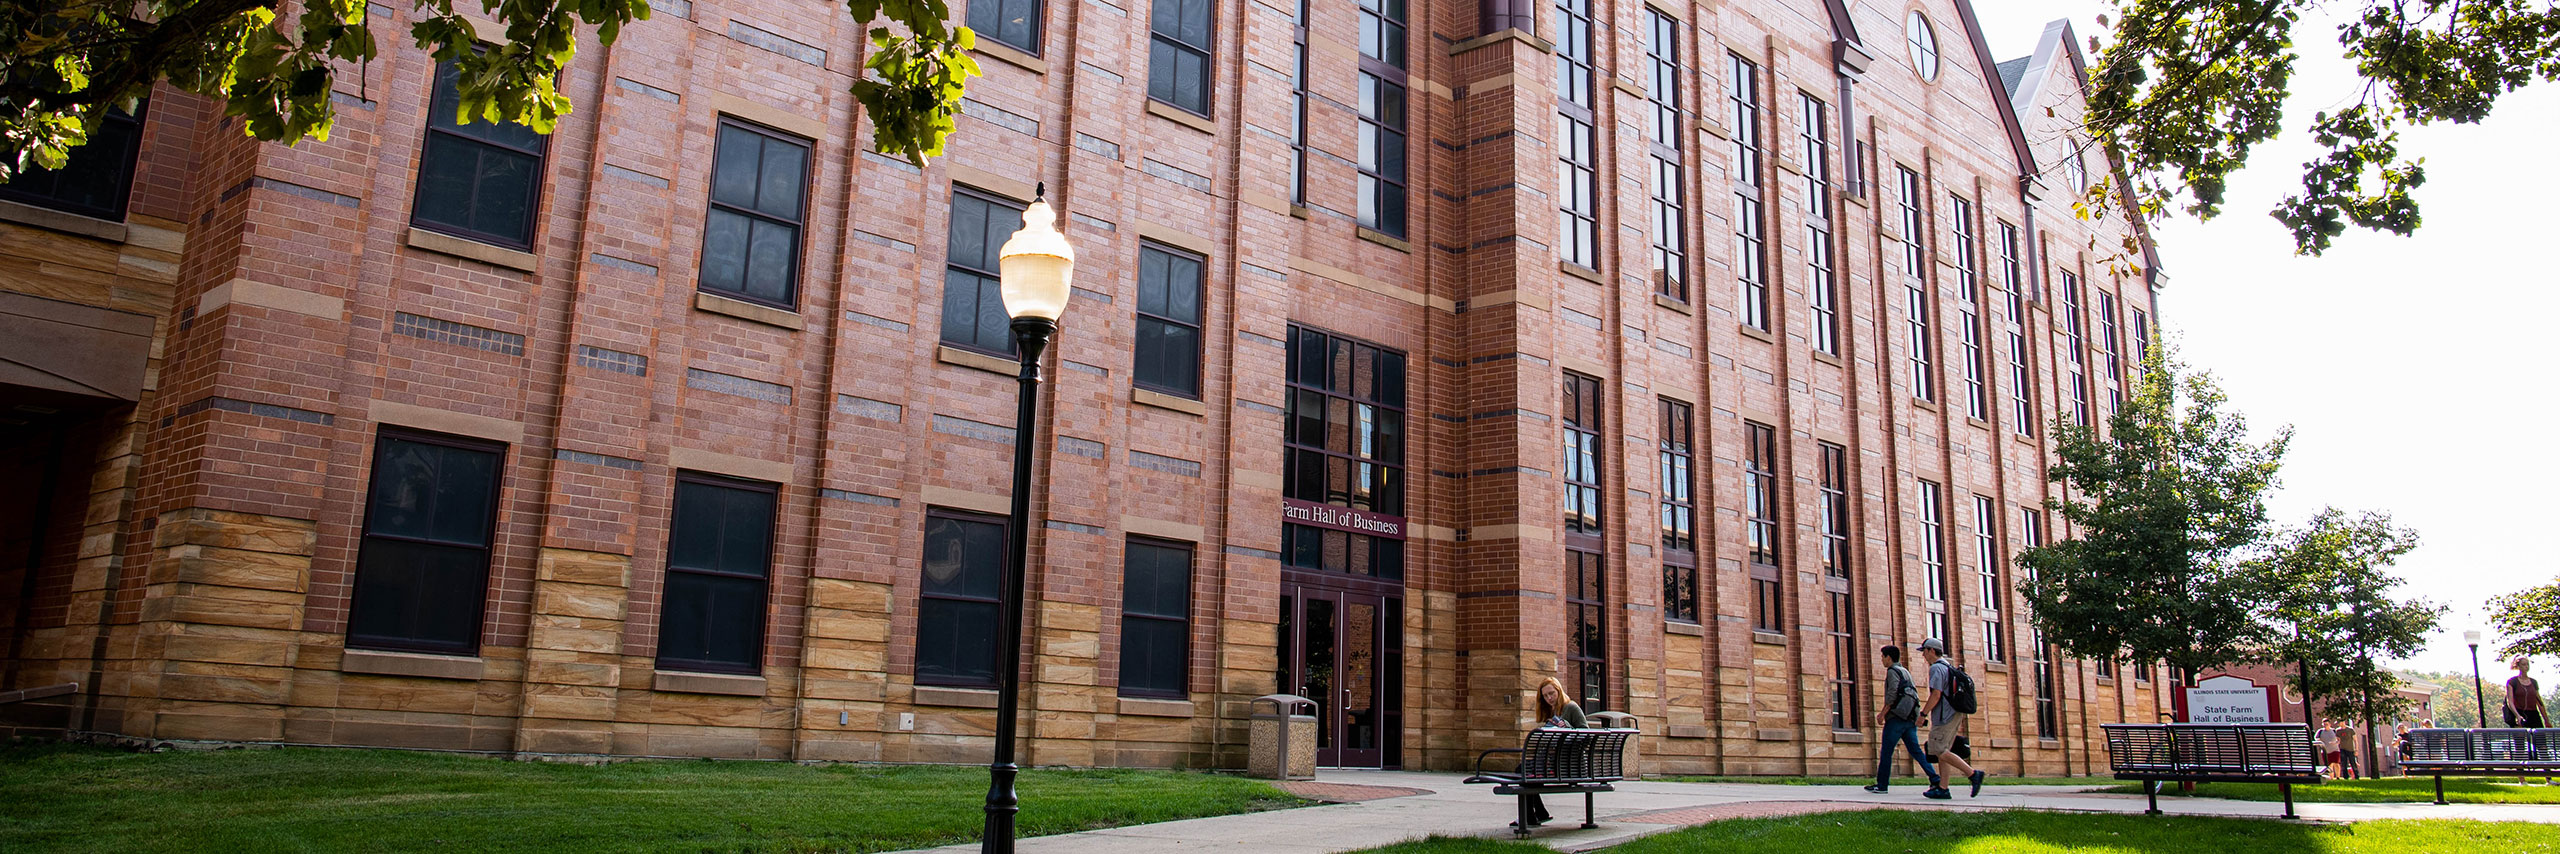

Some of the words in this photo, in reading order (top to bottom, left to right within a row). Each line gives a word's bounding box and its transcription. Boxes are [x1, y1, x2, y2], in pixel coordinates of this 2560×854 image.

[1282, 501, 1309, 520] Farm
[1312, 506, 1336, 524] Hall
[1339, 512, 1351, 526] of
[1354, 513, 1398, 534] Business
[2204, 706, 2228, 714] State
[2230, 706, 2252, 714] Farm
